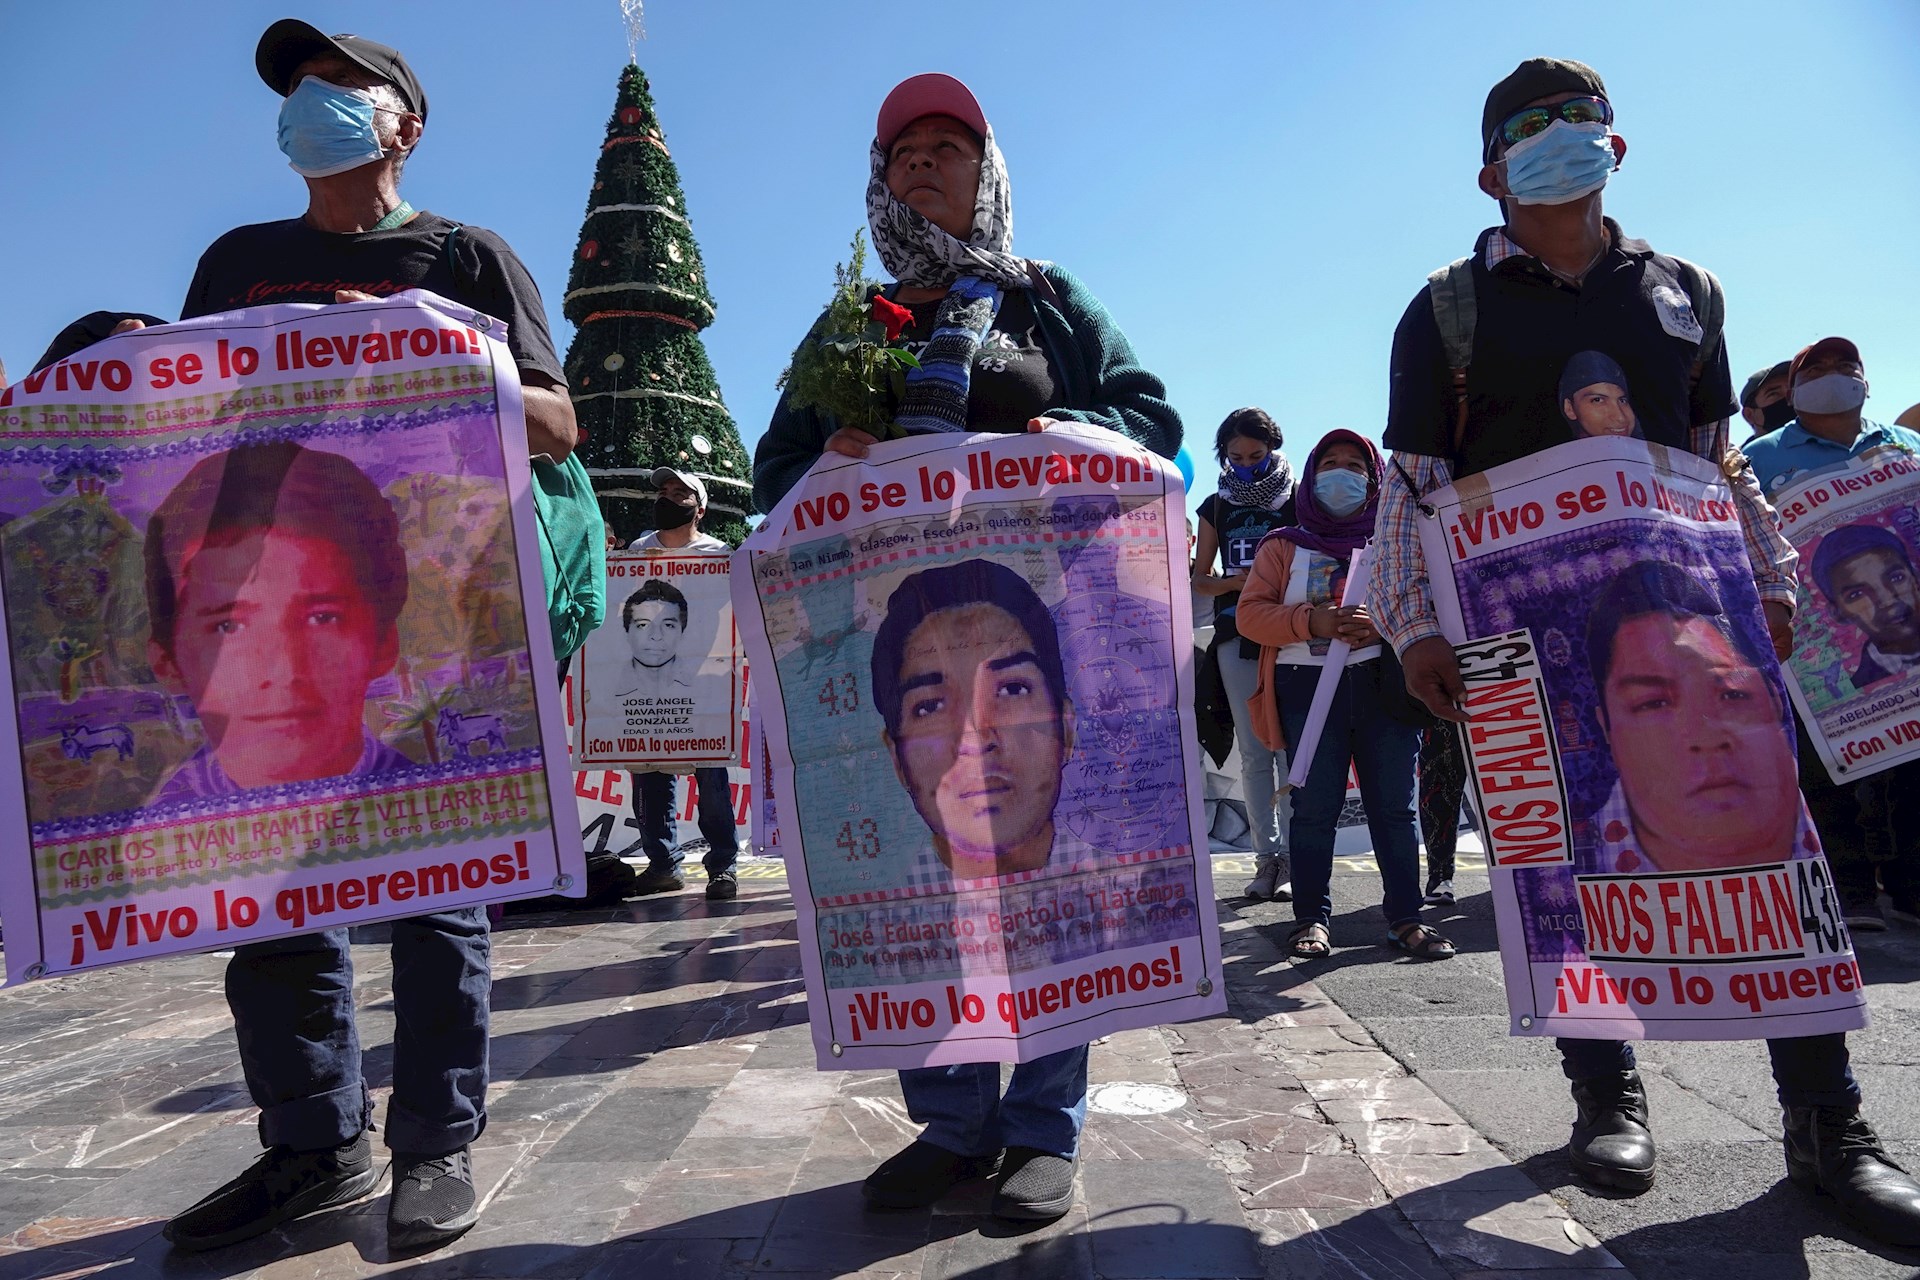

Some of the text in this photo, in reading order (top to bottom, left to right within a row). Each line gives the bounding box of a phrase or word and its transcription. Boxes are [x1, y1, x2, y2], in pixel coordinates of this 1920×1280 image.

[149, 353, 203, 389] se
[217, 339, 259, 378] lo
[276, 327, 482, 371] llevaron!
[1, 413, 28, 427] Yo,
[39, 412, 69, 425] Jan
[78, 412, 136, 426] Nimmo,
[145, 404, 211, 423] Glasgow,
[220, 392, 284, 411] Escocia,
[355, 381, 396, 396] saber
[404, 373, 445, 391] dónde
[451, 371, 486, 385] está
[860, 482, 907, 513] se
[918, 466, 955, 503] lo
[967, 450, 1154, 491] llevaron!
[1782, 501, 1808, 523] se
[1804, 488, 1830, 508] lo
[1450, 502, 1545, 560] ¡Vivo
[1556, 484, 1607, 520] se
[1616, 471, 1647, 508] lo
[629, 565, 645, 576] se
[650, 562, 663, 576] lo
[667, 561, 730, 577] llevaron!
[761, 566, 783, 579] Yo,
[791, 560, 812, 572] Jan
[818, 550, 854, 566] Nimmo,
[860, 534, 915, 552] Glasgow,
[923, 521, 980, 540] Escocia,
[988, 515, 1032, 530] quiero
[1038, 511, 1075, 525] saber
[1127, 509, 1158, 521] está
[622, 698, 652, 706] JOSÉ
[625, 708, 693, 716] NAVARRETE
[626, 717, 689, 725] GONZÁLEZ
[818, 672, 859, 717] 43
[1839, 693, 1905, 726] ABELARDO
[589, 736, 726, 755] ¡Con VIDA lo queremos!
[1464, 678, 1553, 794] FALTAN
[1840, 736, 1886, 765] ¡Con
[58, 781, 528, 872] CARLOS IVÁN RAMÍREZ VILLARREAL
[64, 875, 99, 889] Hijo
[107, 870, 123, 882] de
[130, 858, 203, 878] Margarito
[210, 855, 218, 867] y
[226, 846, 282, 863] Socorro
[305, 838, 321, 850] 19
[328, 831, 360, 847] años
[383, 823, 423, 838] Cerro
[430, 815, 475, 831] Gordo,
[482, 805, 528, 825] Ayutla
[836, 818, 880, 861] 43
[1487, 799, 1564, 865] NOS
[70, 840, 531, 966] ¡Vivo lo queremos!
[829, 882, 1186, 949] José Eduardo Bartolo Tlatempa
[1579, 882, 1655, 954] NOS
[1658, 873, 1804, 955] FALTAN
[831, 955, 857, 969] Hijo
[1555, 968, 1658, 1013] ¡Vivo
[1668, 967, 1714, 1005] lo
[848, 946, 1183, 1041] ¡Vivo lo queremos!
